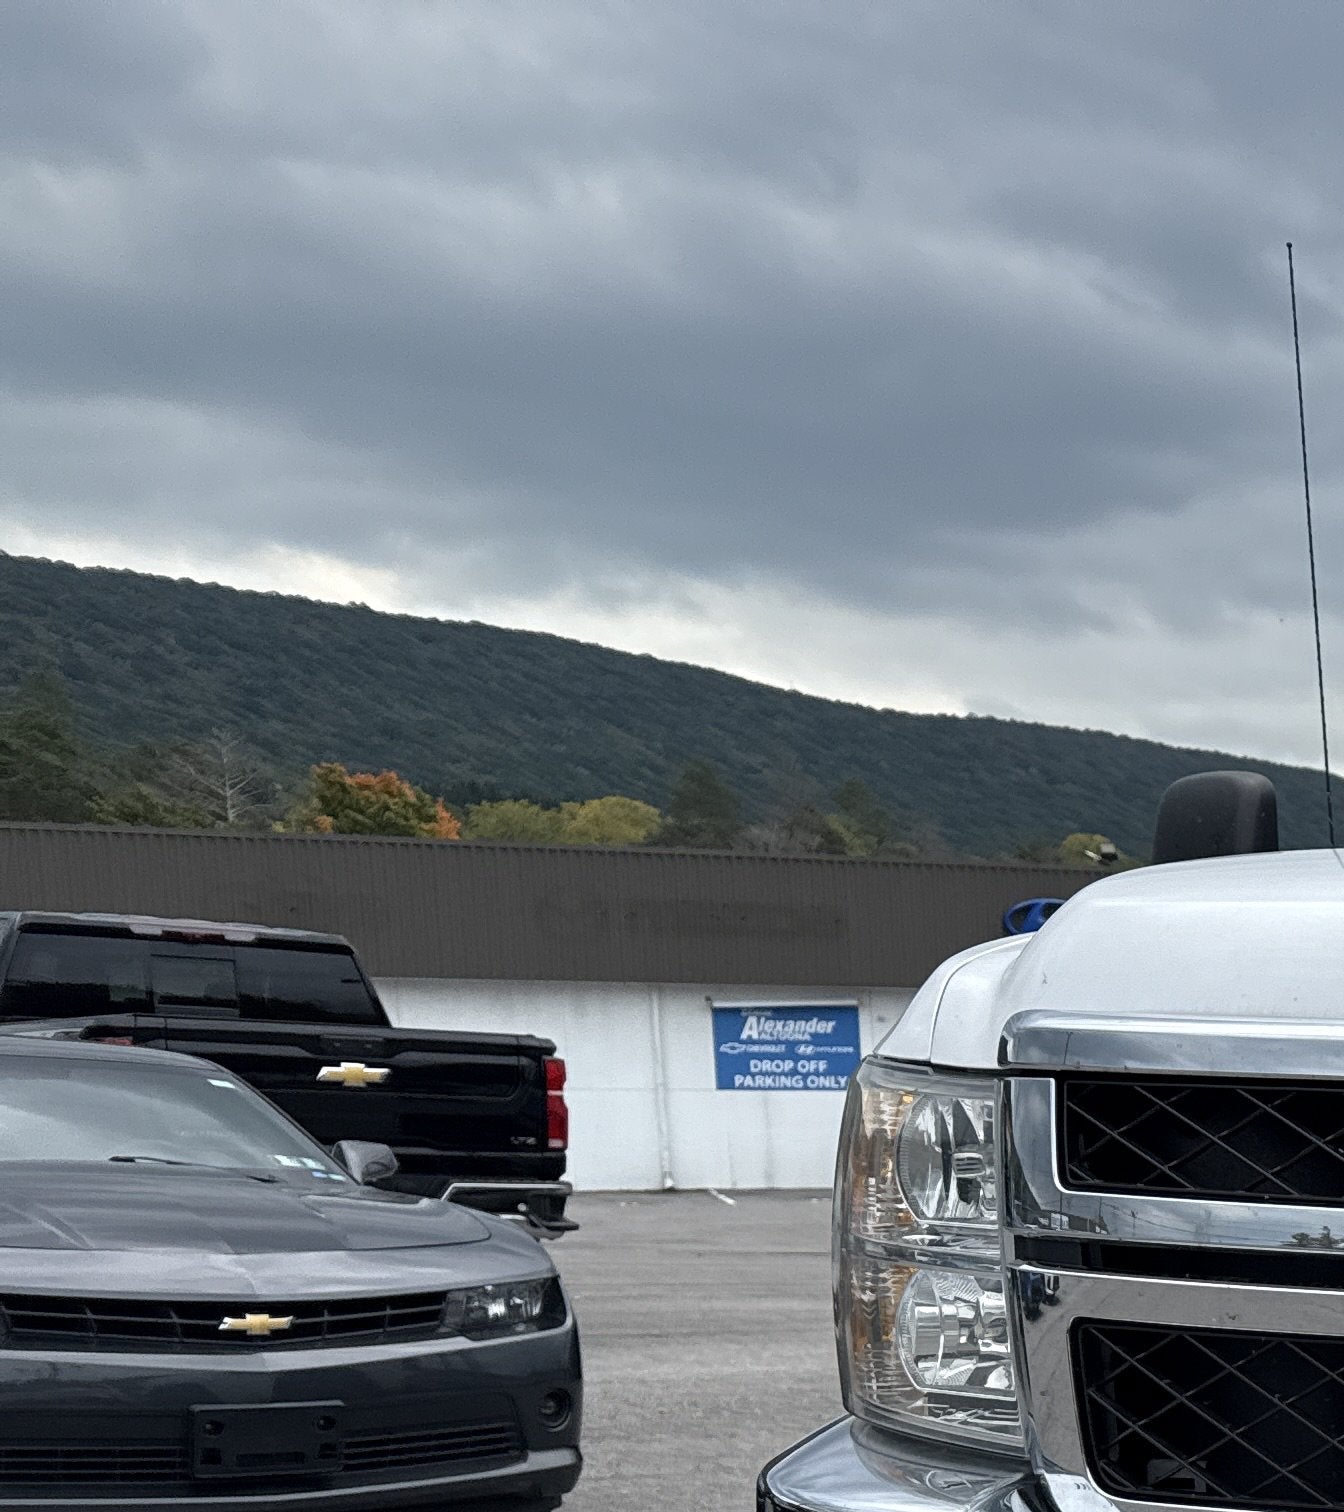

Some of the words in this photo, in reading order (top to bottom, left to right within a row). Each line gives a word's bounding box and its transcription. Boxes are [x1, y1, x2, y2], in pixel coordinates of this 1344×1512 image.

[740, 1016, 836, 1041] Alexander
[750, 1059, 794, 1073] DROP
[797, 1059, 828, 1073] OFF
[734, 1074, 804, 1088] PARKING
[807, 1074, 848, 1089] ONLY
